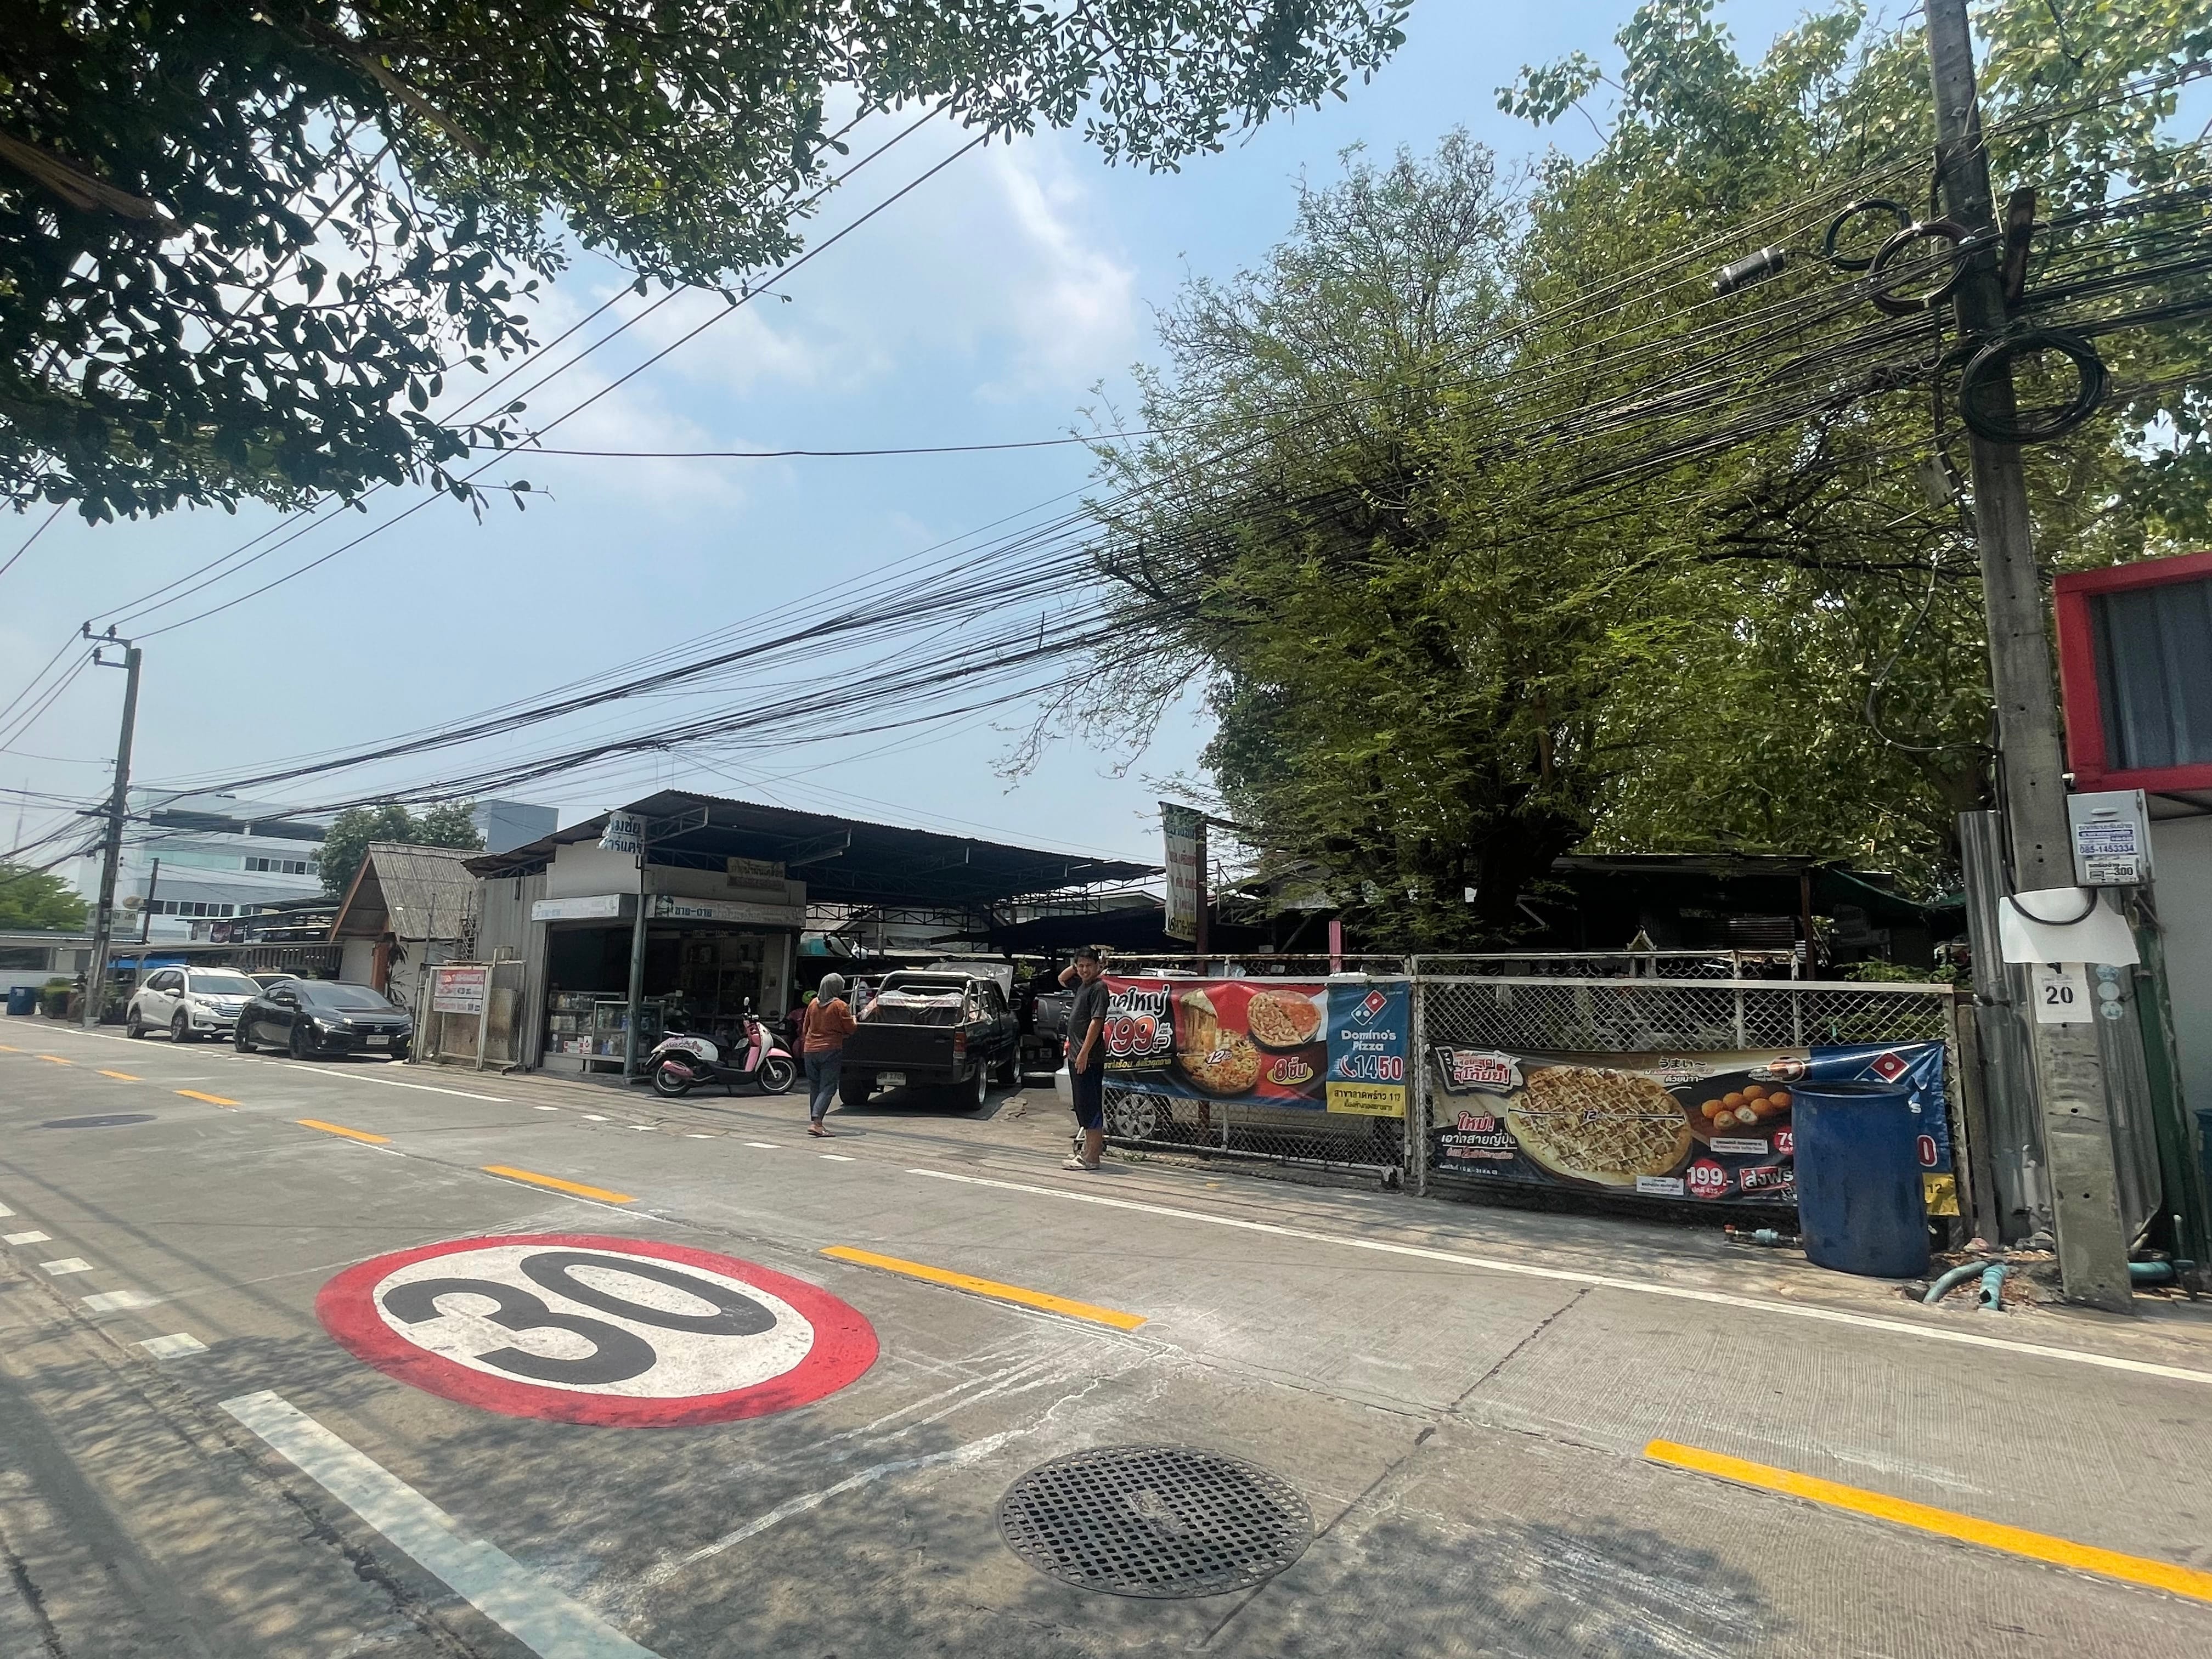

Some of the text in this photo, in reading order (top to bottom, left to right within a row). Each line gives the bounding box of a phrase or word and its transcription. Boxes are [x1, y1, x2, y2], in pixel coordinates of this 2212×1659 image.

[610, 815, 641, 833] มชัย
[606, 836, 644, 854] าร์แคร์
[2045, 986, 2073, 1004] 20
[1341, 1029, 1397, 1040] Domino's
[1352, 1041, 1384, 1051] Pizza
[1207, 1050, 1224, 1063] 12
[1274, 1058, 1287, 1081] 8
[1355, 1054, 1403, 1081] 1450
[1458, 1111, 1494, 1131] ใหม่!
[1584, 1110, 1597, 1120] 12
[382, 1251, 777, 1384] 30
